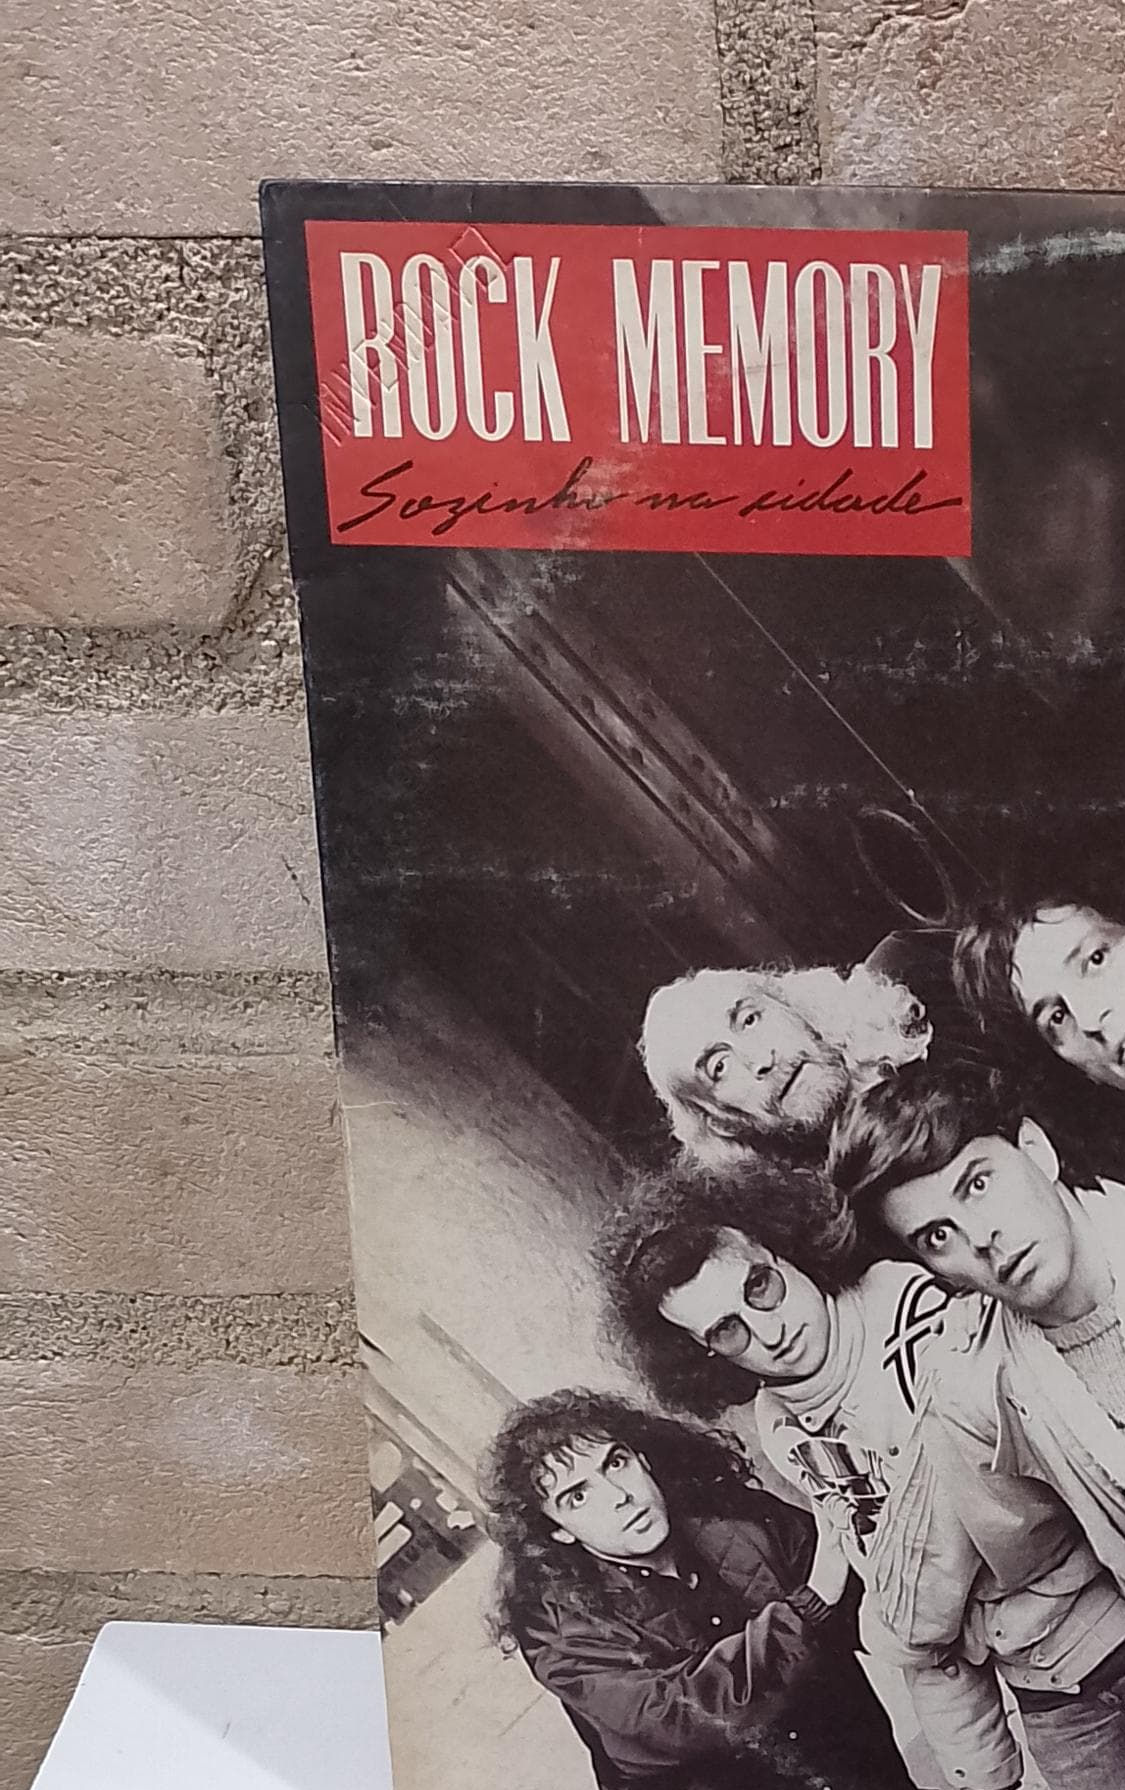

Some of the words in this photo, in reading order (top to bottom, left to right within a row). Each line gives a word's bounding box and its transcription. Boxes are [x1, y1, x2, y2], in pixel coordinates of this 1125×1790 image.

[339, 252, 572, 443] ROCK
[611, 258, 943, 449] MEMORY
[338, 456, 629, 534] Sozinho
[631, 481, 738, 515] na
[738, 467, 964, 519] cidade
